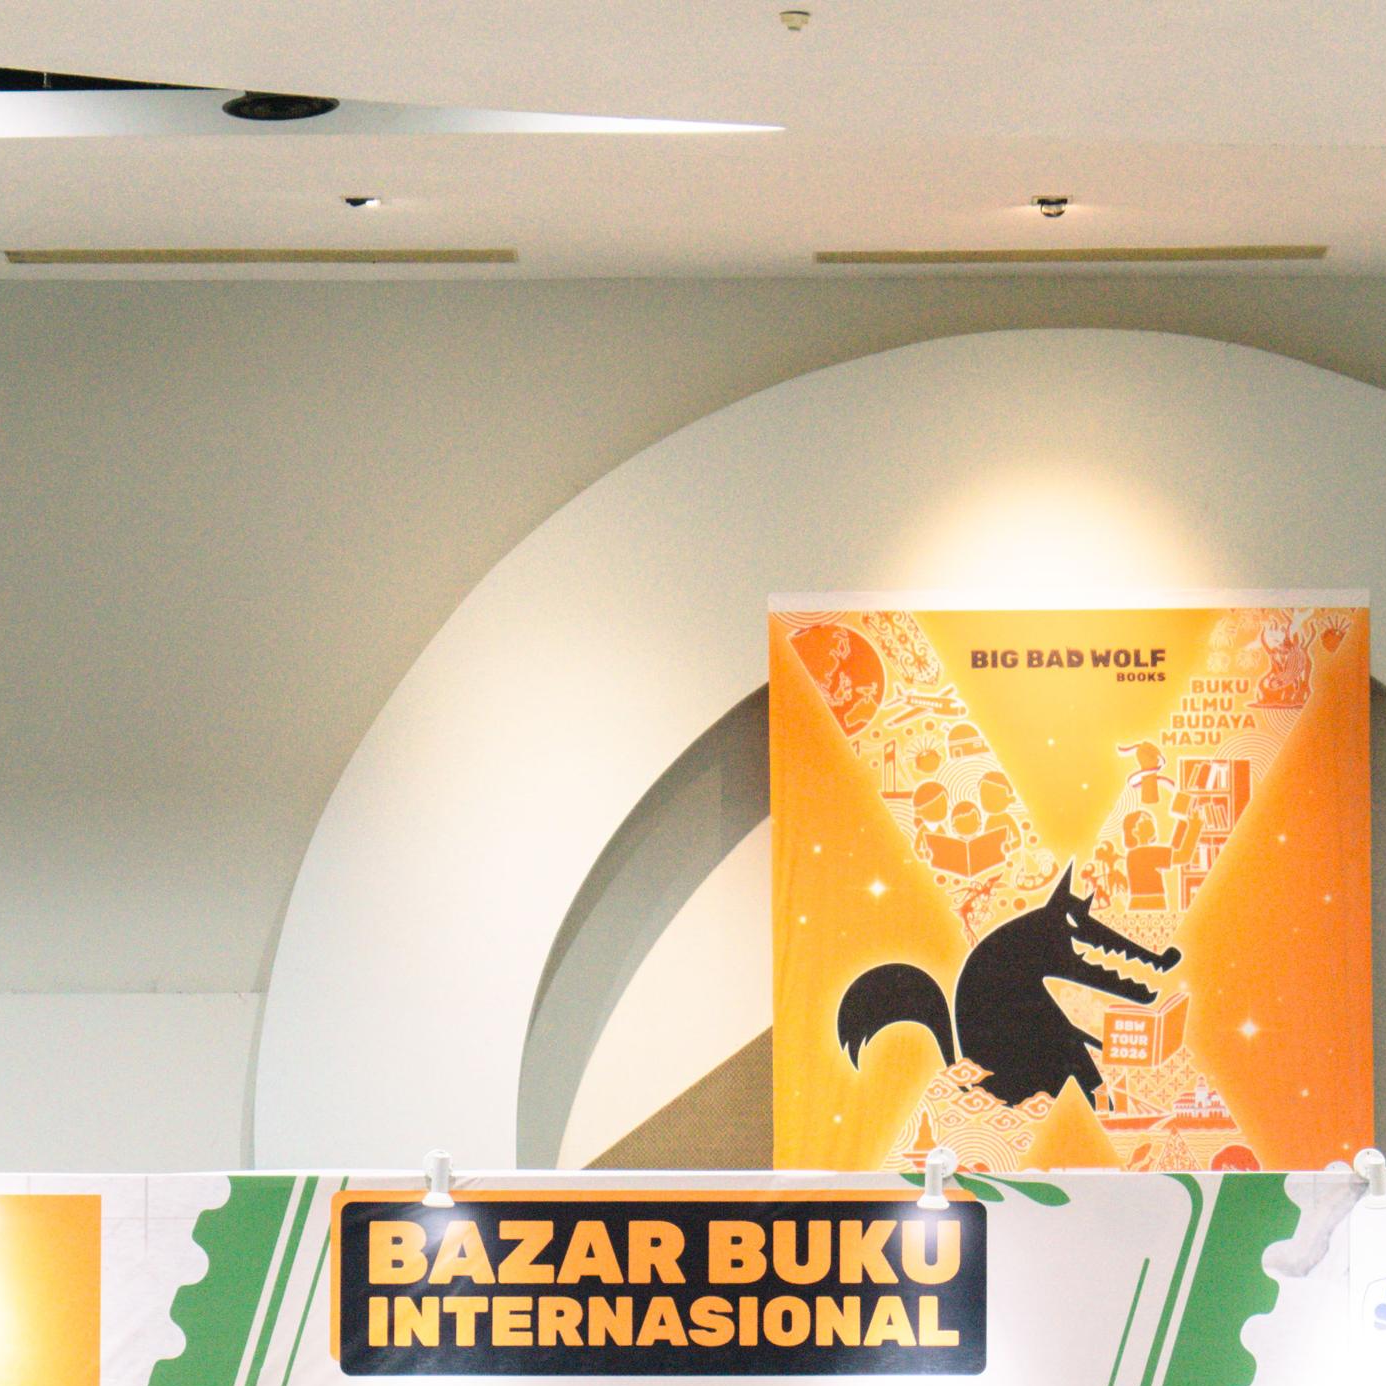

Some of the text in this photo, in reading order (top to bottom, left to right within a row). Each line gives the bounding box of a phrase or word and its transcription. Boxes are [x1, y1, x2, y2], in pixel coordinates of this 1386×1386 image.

[971, 649, 1166, 669] BIG BAD WOLF
[1116, 671, 1166, 683] BOOKS
[1191, 679, 1249, 695] BUKU
[1182, 698, 1233, 713] ILMU
[1172, 714, 1256, 730] BUDAYA
[1161, 731, 1222, 747] MAJU
[1114, 1020, 1146, 1031] BBW
[1111, 1034, 1148, 1046] TOUR
[1110, 1047, 1148, 1061] 2026
[368, 1220, 961, 1285] BAZAR BUKU
[367, 1296, 960, 1348] INTERNASIONAL
